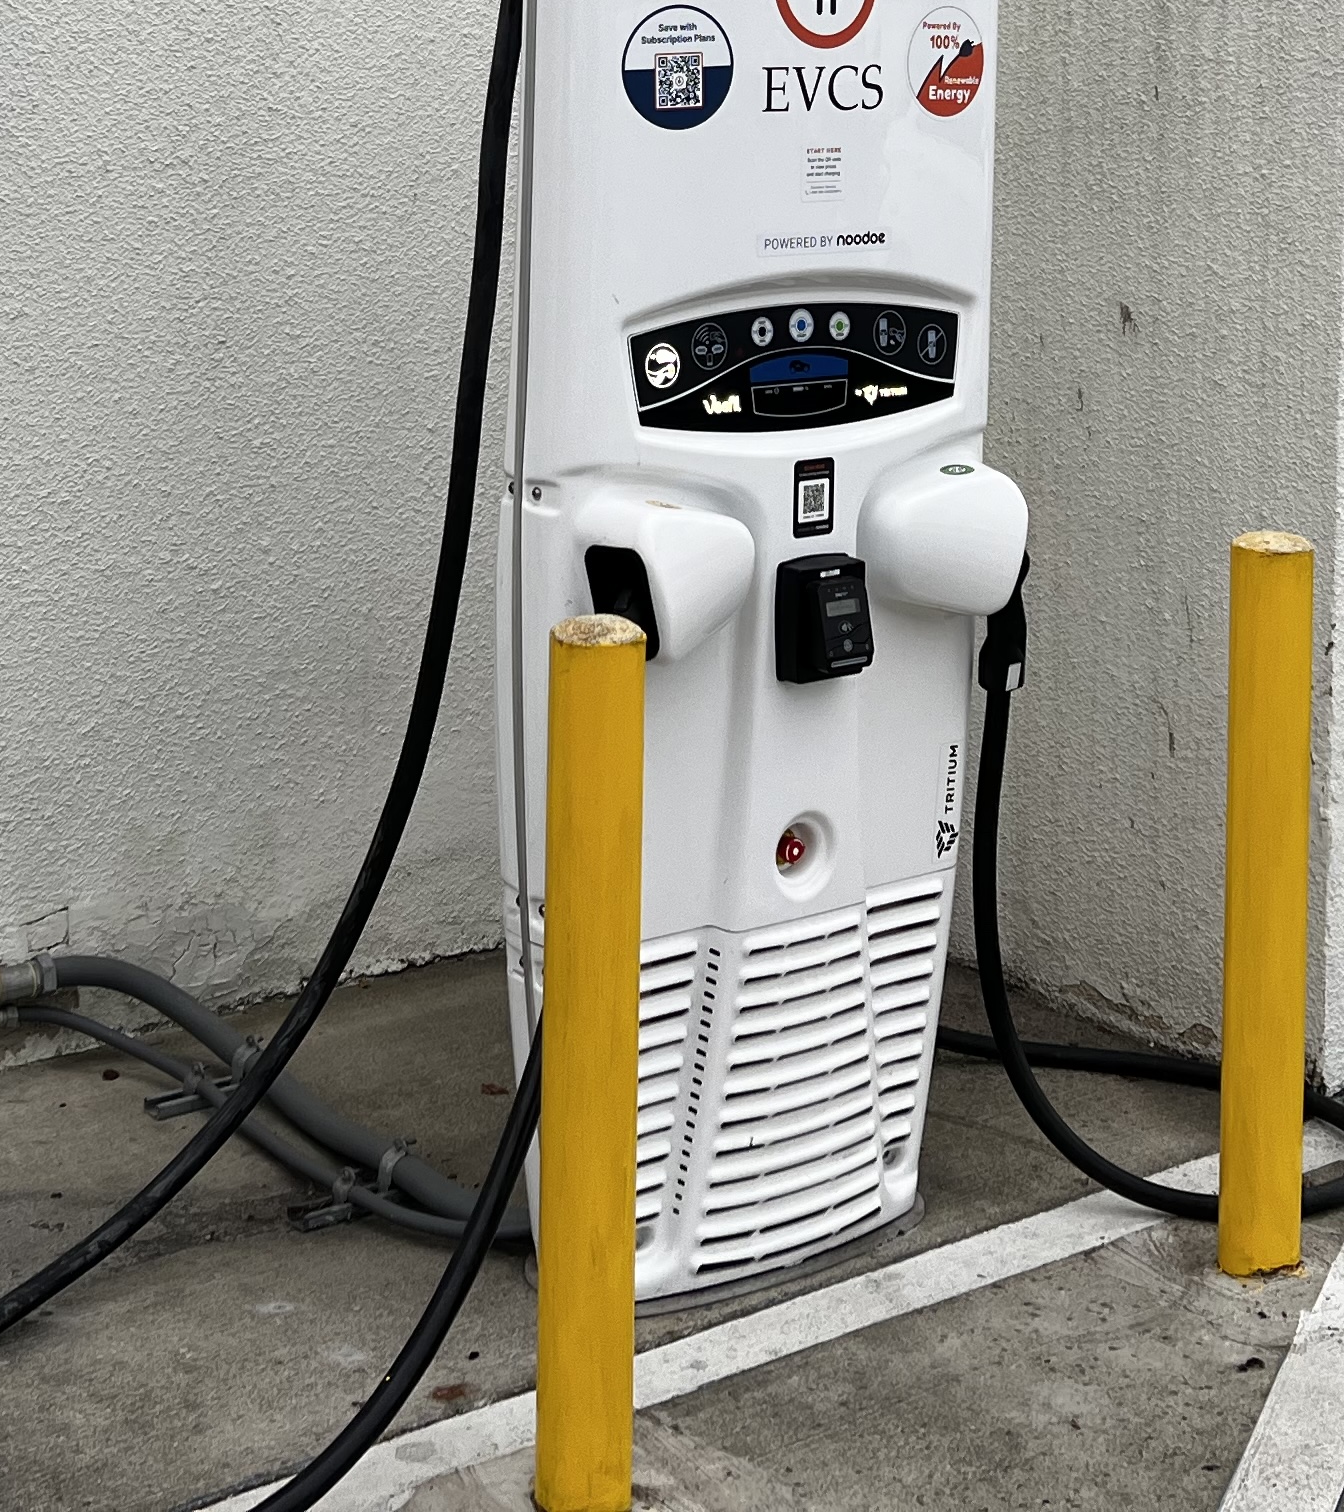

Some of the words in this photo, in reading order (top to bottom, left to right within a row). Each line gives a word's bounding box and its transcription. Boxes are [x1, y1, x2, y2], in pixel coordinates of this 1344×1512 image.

[658, 23, 678, 32] Save
[680, 22, 697, 31] with
[922, 21, 951, 30] Powered
[641, 34, 693, 45] Subscription
[694, 33, 716, 42] Plans
[930, 34, 960, 49] 100%
[762, 64, 884, 113] EVCS
[928, 85, 971, 104] Energy
[764, 236, 817, 250] POWERED
[820, 235, 834, 247] BY
[836, 230, 886, 246] noodoe
[944, 744, 958, 814] TRITIUM
